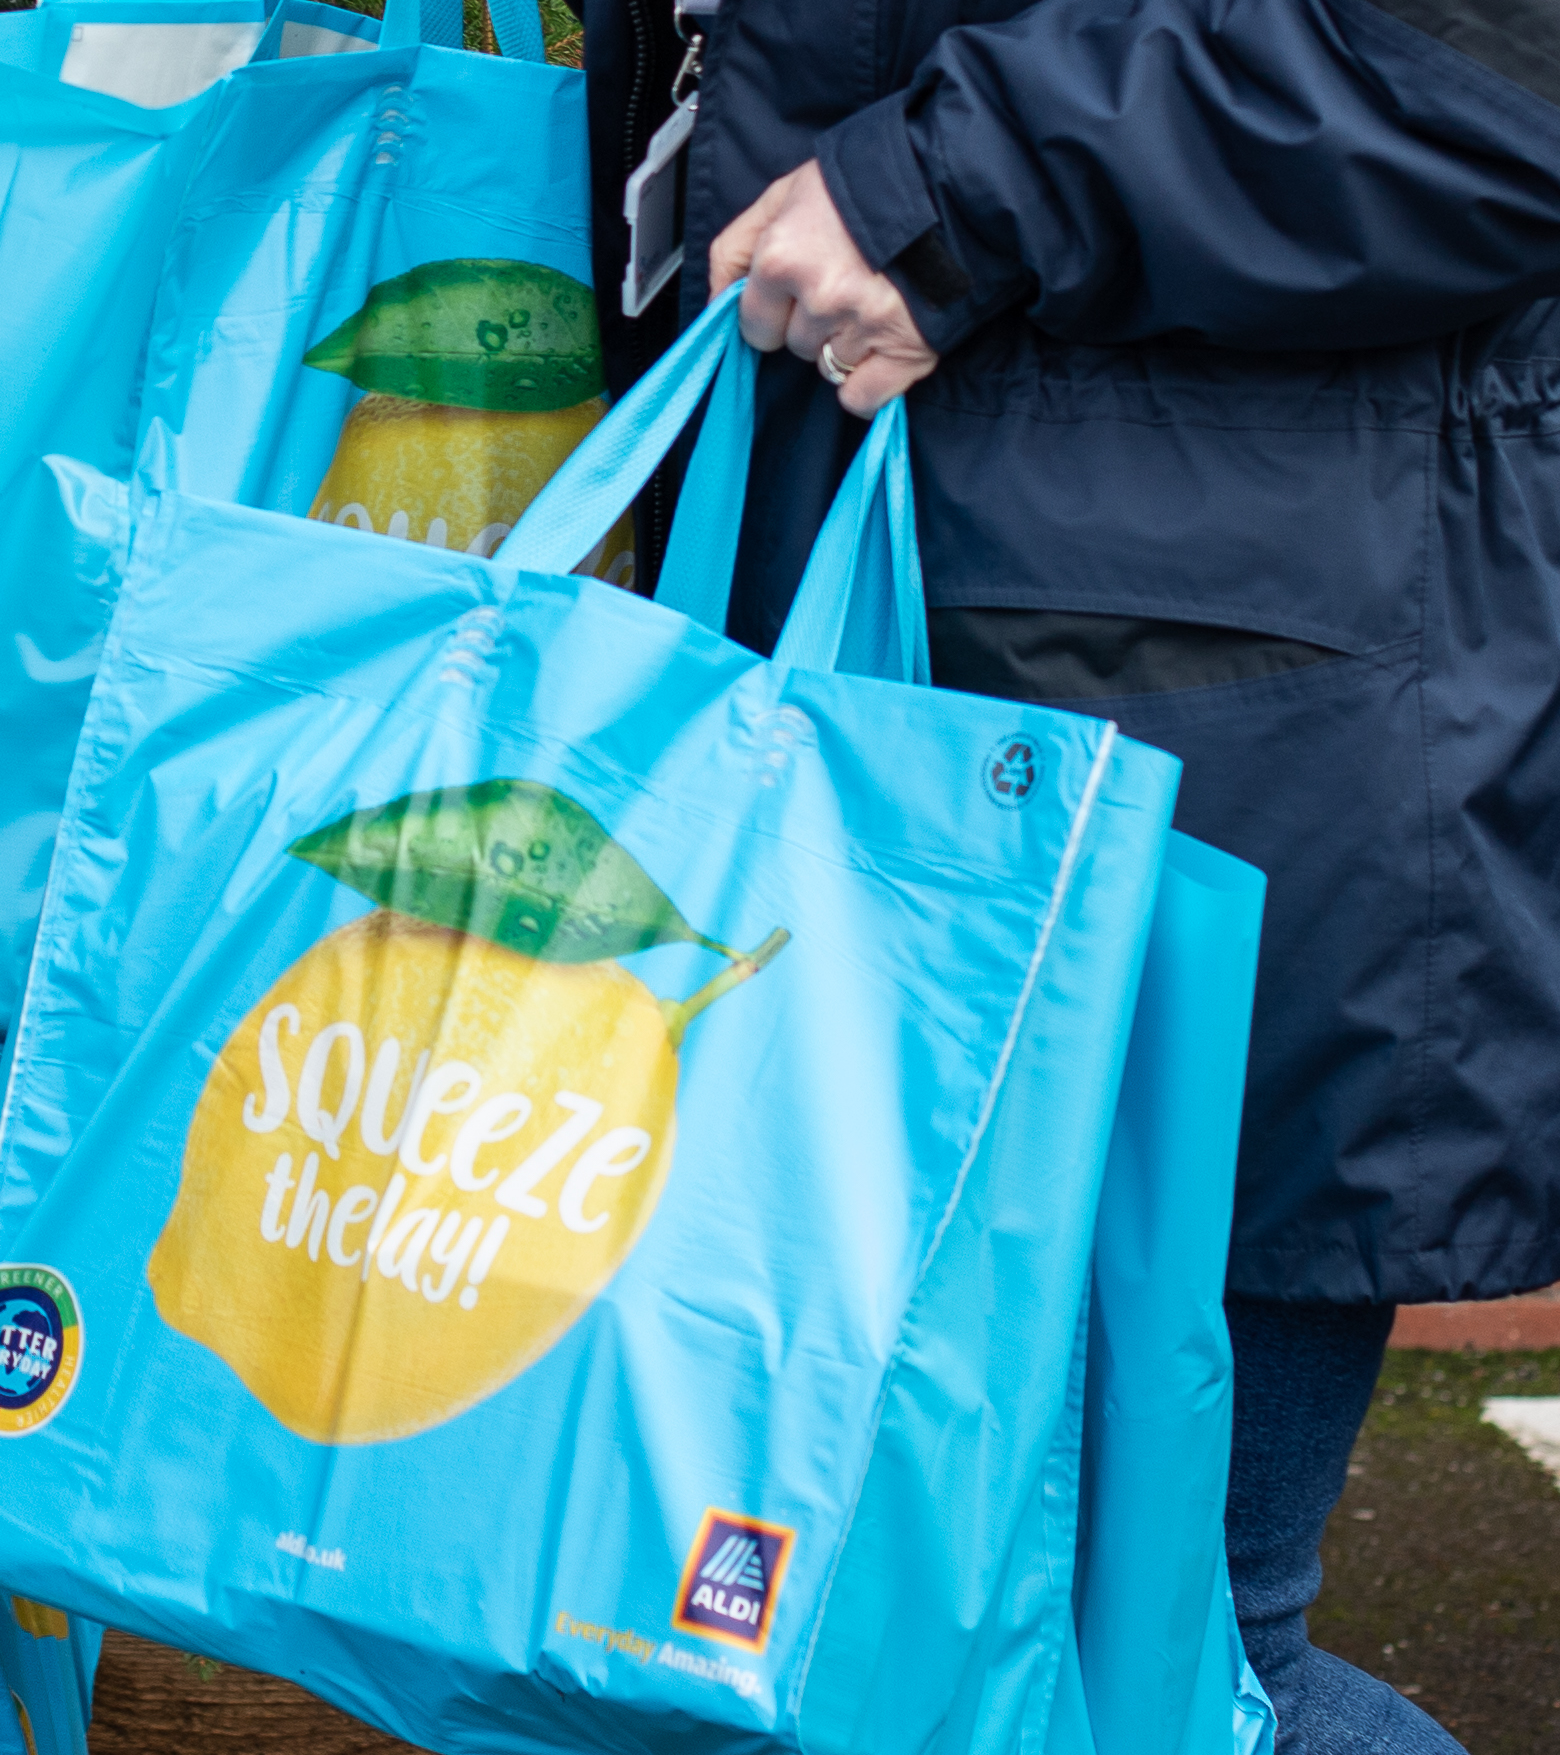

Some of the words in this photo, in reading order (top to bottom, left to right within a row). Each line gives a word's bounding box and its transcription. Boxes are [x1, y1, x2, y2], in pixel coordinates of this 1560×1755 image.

[259, 1151, 379, 1267] the
[690, 1583, 761, 1626] ALDI
[554, 1610, 656, 1666] Everyday
[657, 1640, 763, 1699] Amazing.
